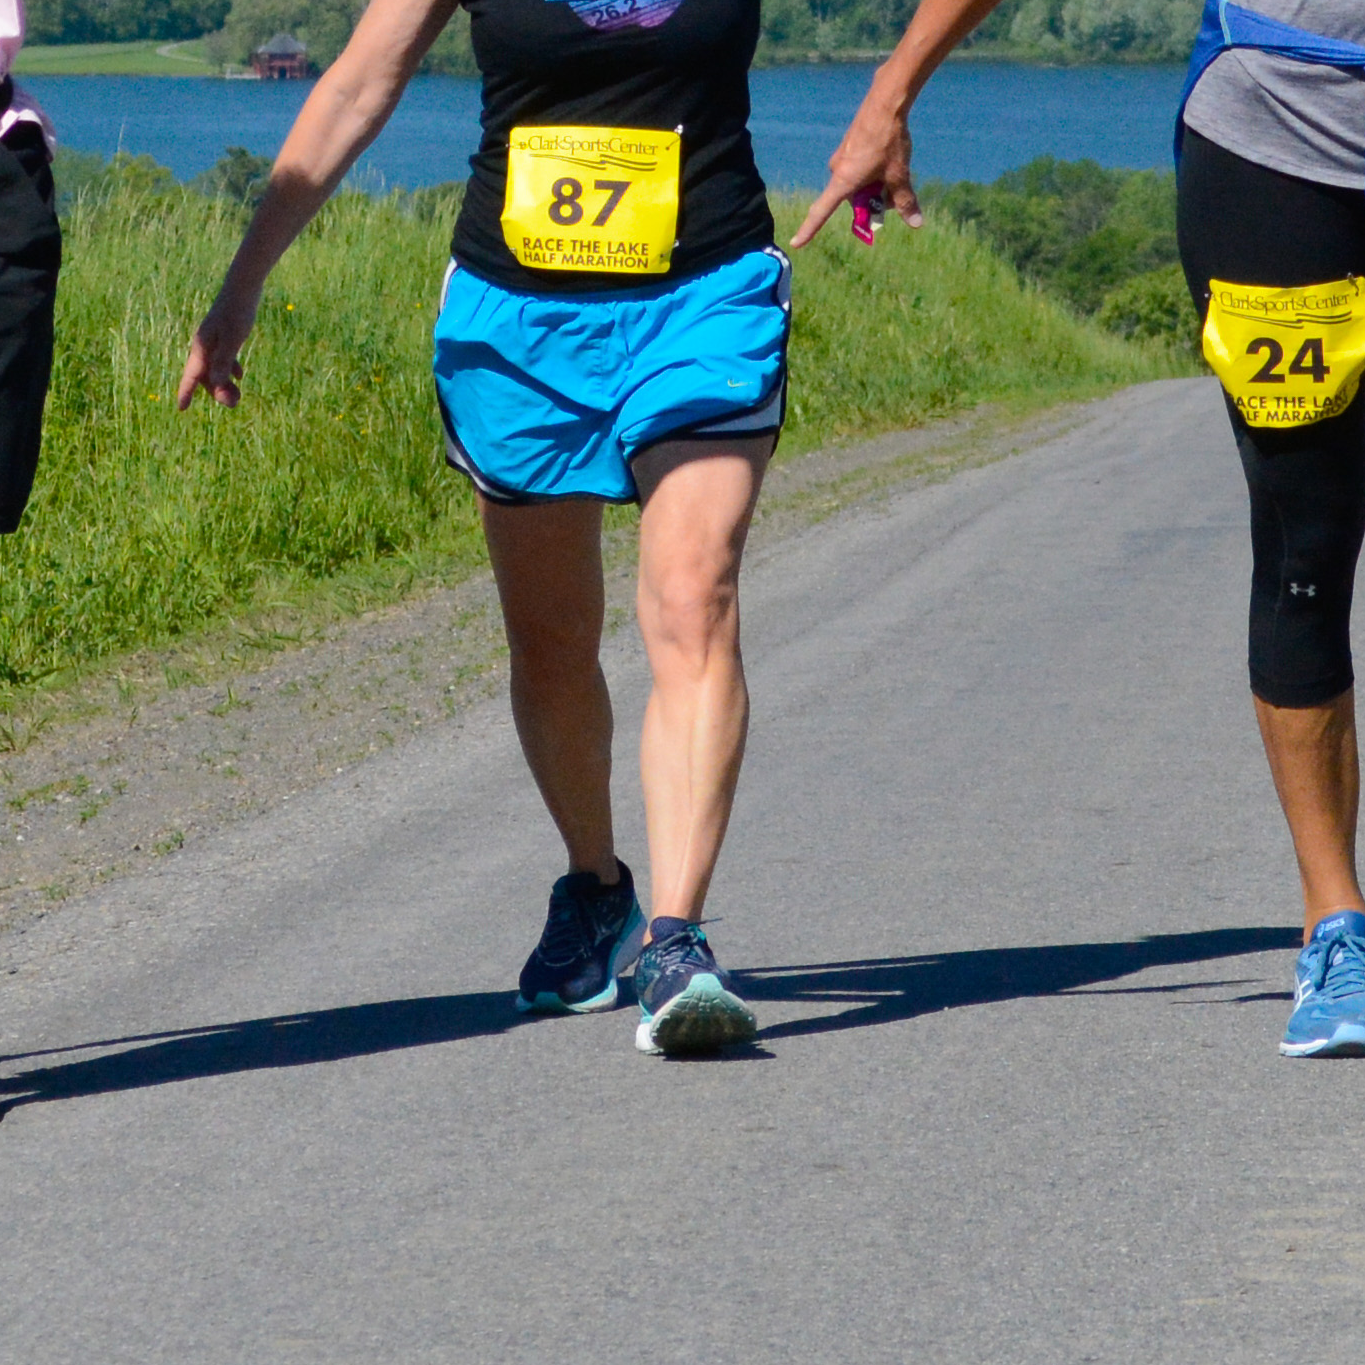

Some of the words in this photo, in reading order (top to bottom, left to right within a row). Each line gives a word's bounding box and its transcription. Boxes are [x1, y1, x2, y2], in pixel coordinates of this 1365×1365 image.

[527, 135, 659, 156] ClarkSportsCenter
[548, 176, 633, 227] 87
[522, 237, 565, 252] RACE
[570, 239, 602, 254] THE
[607, 241, 650, 256] LAKE
[523, 251, 557, 265] HALF
[561, 253, 650, 270] MARATHON
[1219, 290, 1350, 315] ClarkSportsCenter
[1245, 336, 1331, 384] 24
[1234, 396, 1268, 410] ACE
[1273, 396, 1307, 409] THE
